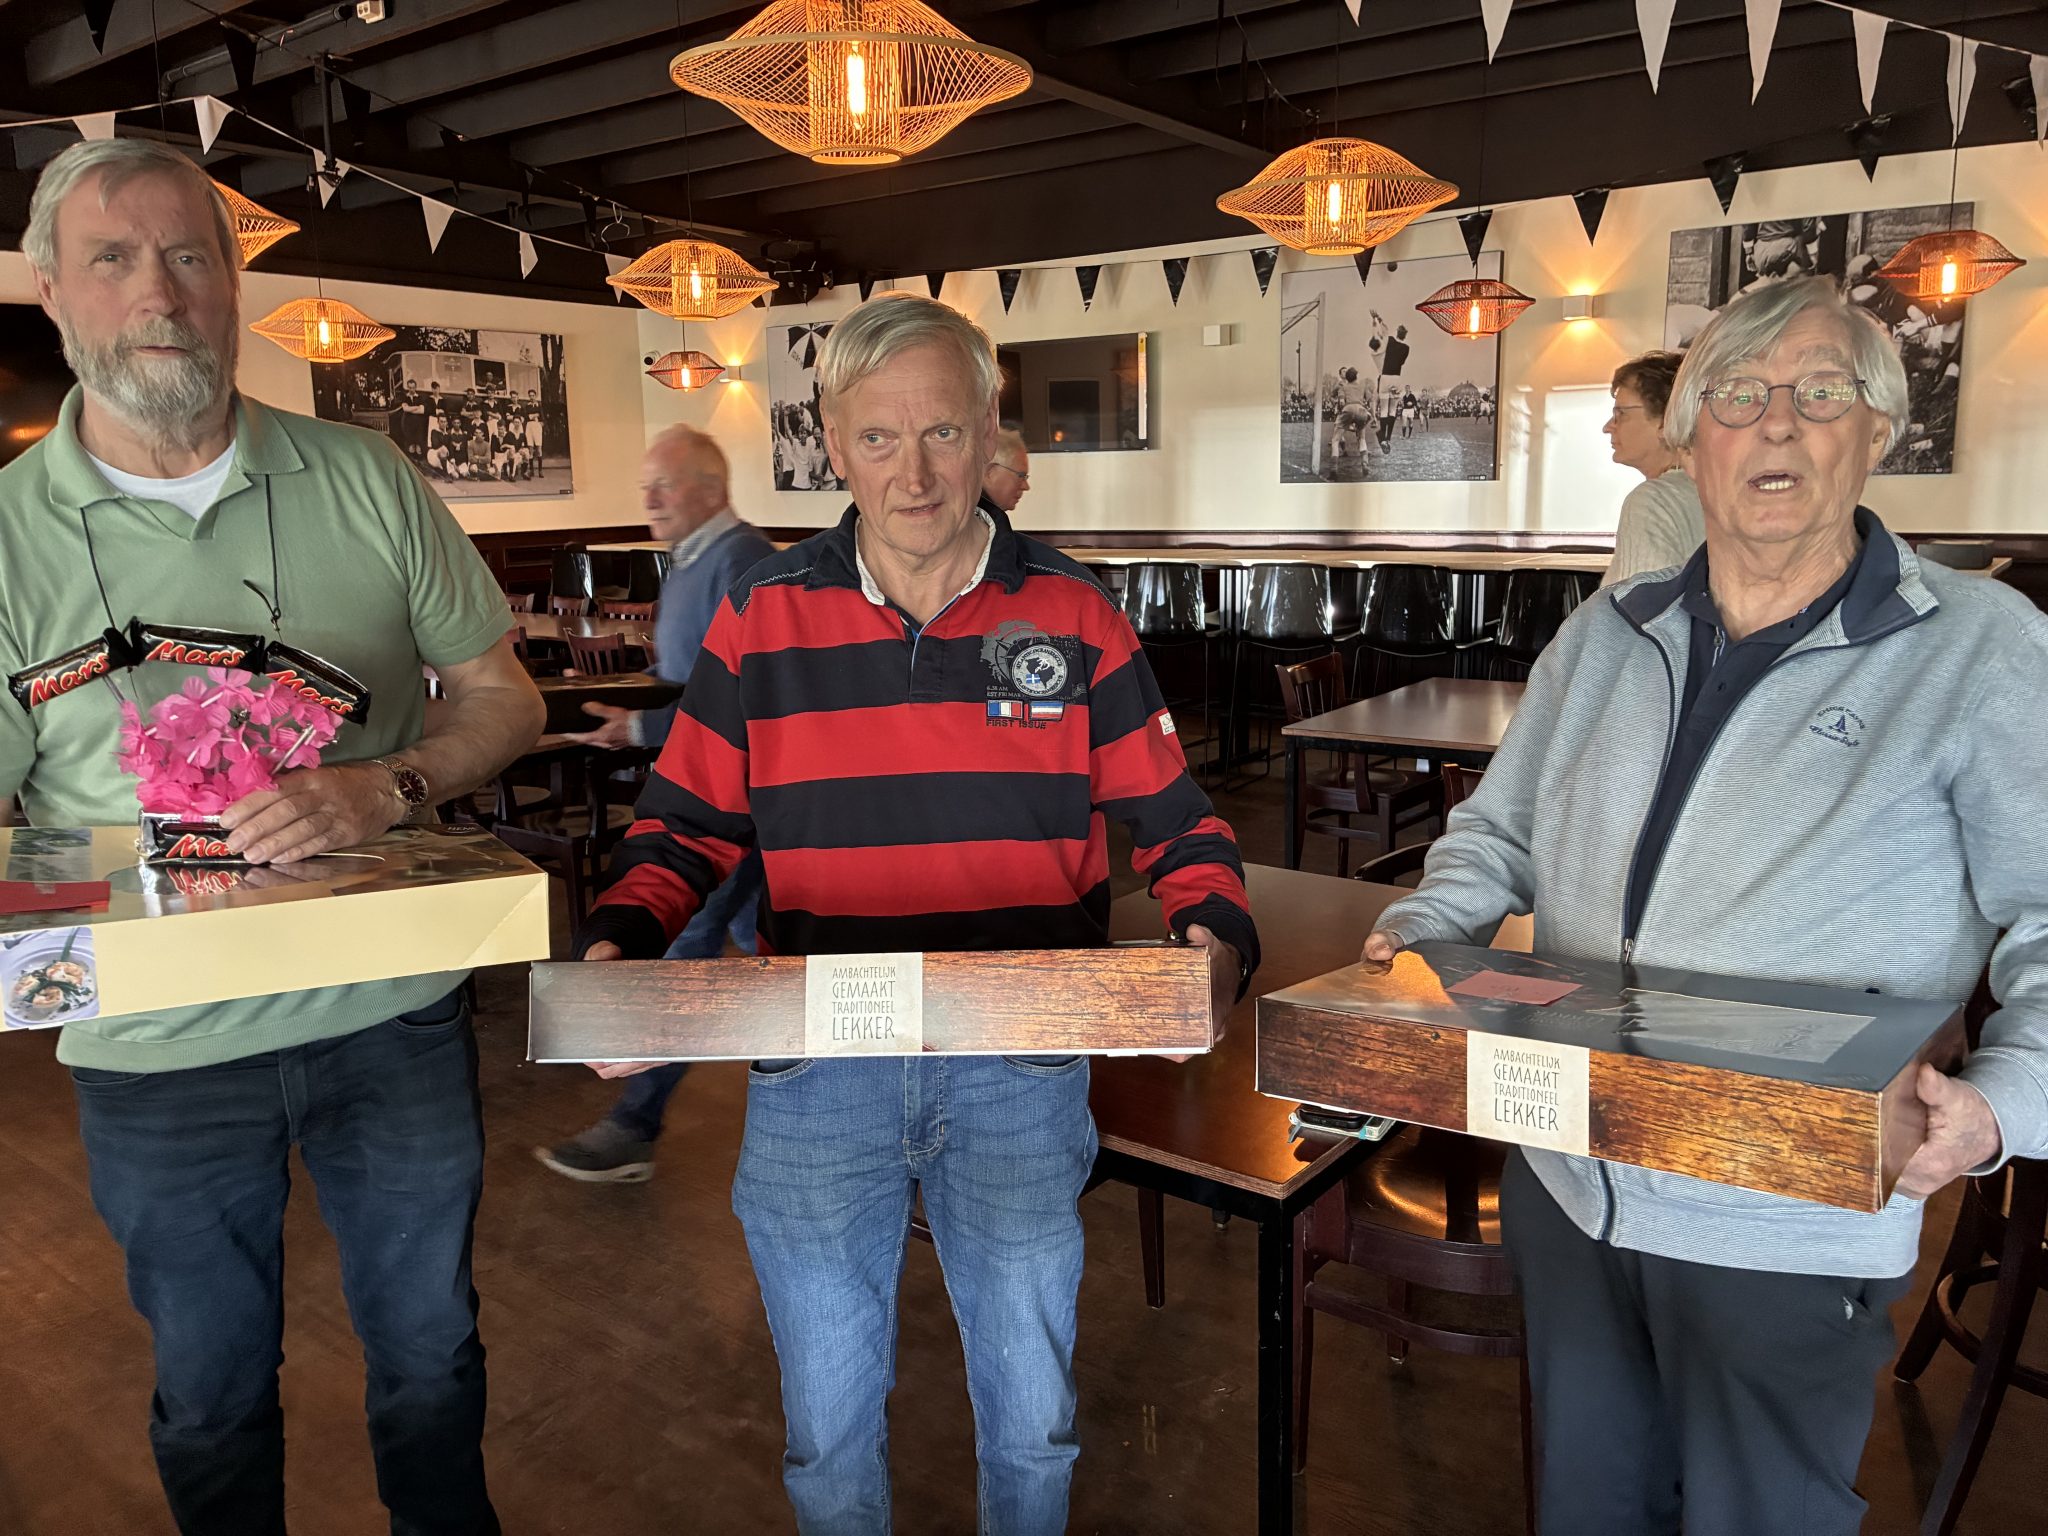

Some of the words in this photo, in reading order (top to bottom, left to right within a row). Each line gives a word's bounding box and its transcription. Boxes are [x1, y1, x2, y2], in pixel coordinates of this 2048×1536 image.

[144, 638, 246, 666] Mars
[29, 651, 111, 708] Mars
[265, 669, 354, 715] Mars
[986, 718, 1015, 728] FIRST
[1018, 719, 1047, 729] ISSUE
[165, 833, 237, 858] Ma
[832, 966, 896, 979] AMBACHTELIJK
[832, 981, 896, 999] GEMAAKT
[832, 1000, 896, 1015] TRADITIONEEL
[832, 1016, 895, 1041] LEKKER
[1493, 1048, 1561, 1070] AMBACHTELIJK
[1493, 1062, 1561, 1090] GEMAAKT
[1494, 1082, 1560, 1106] TRADITIONEEL
[1494, 1098, 1560, 1132] LEKKER
